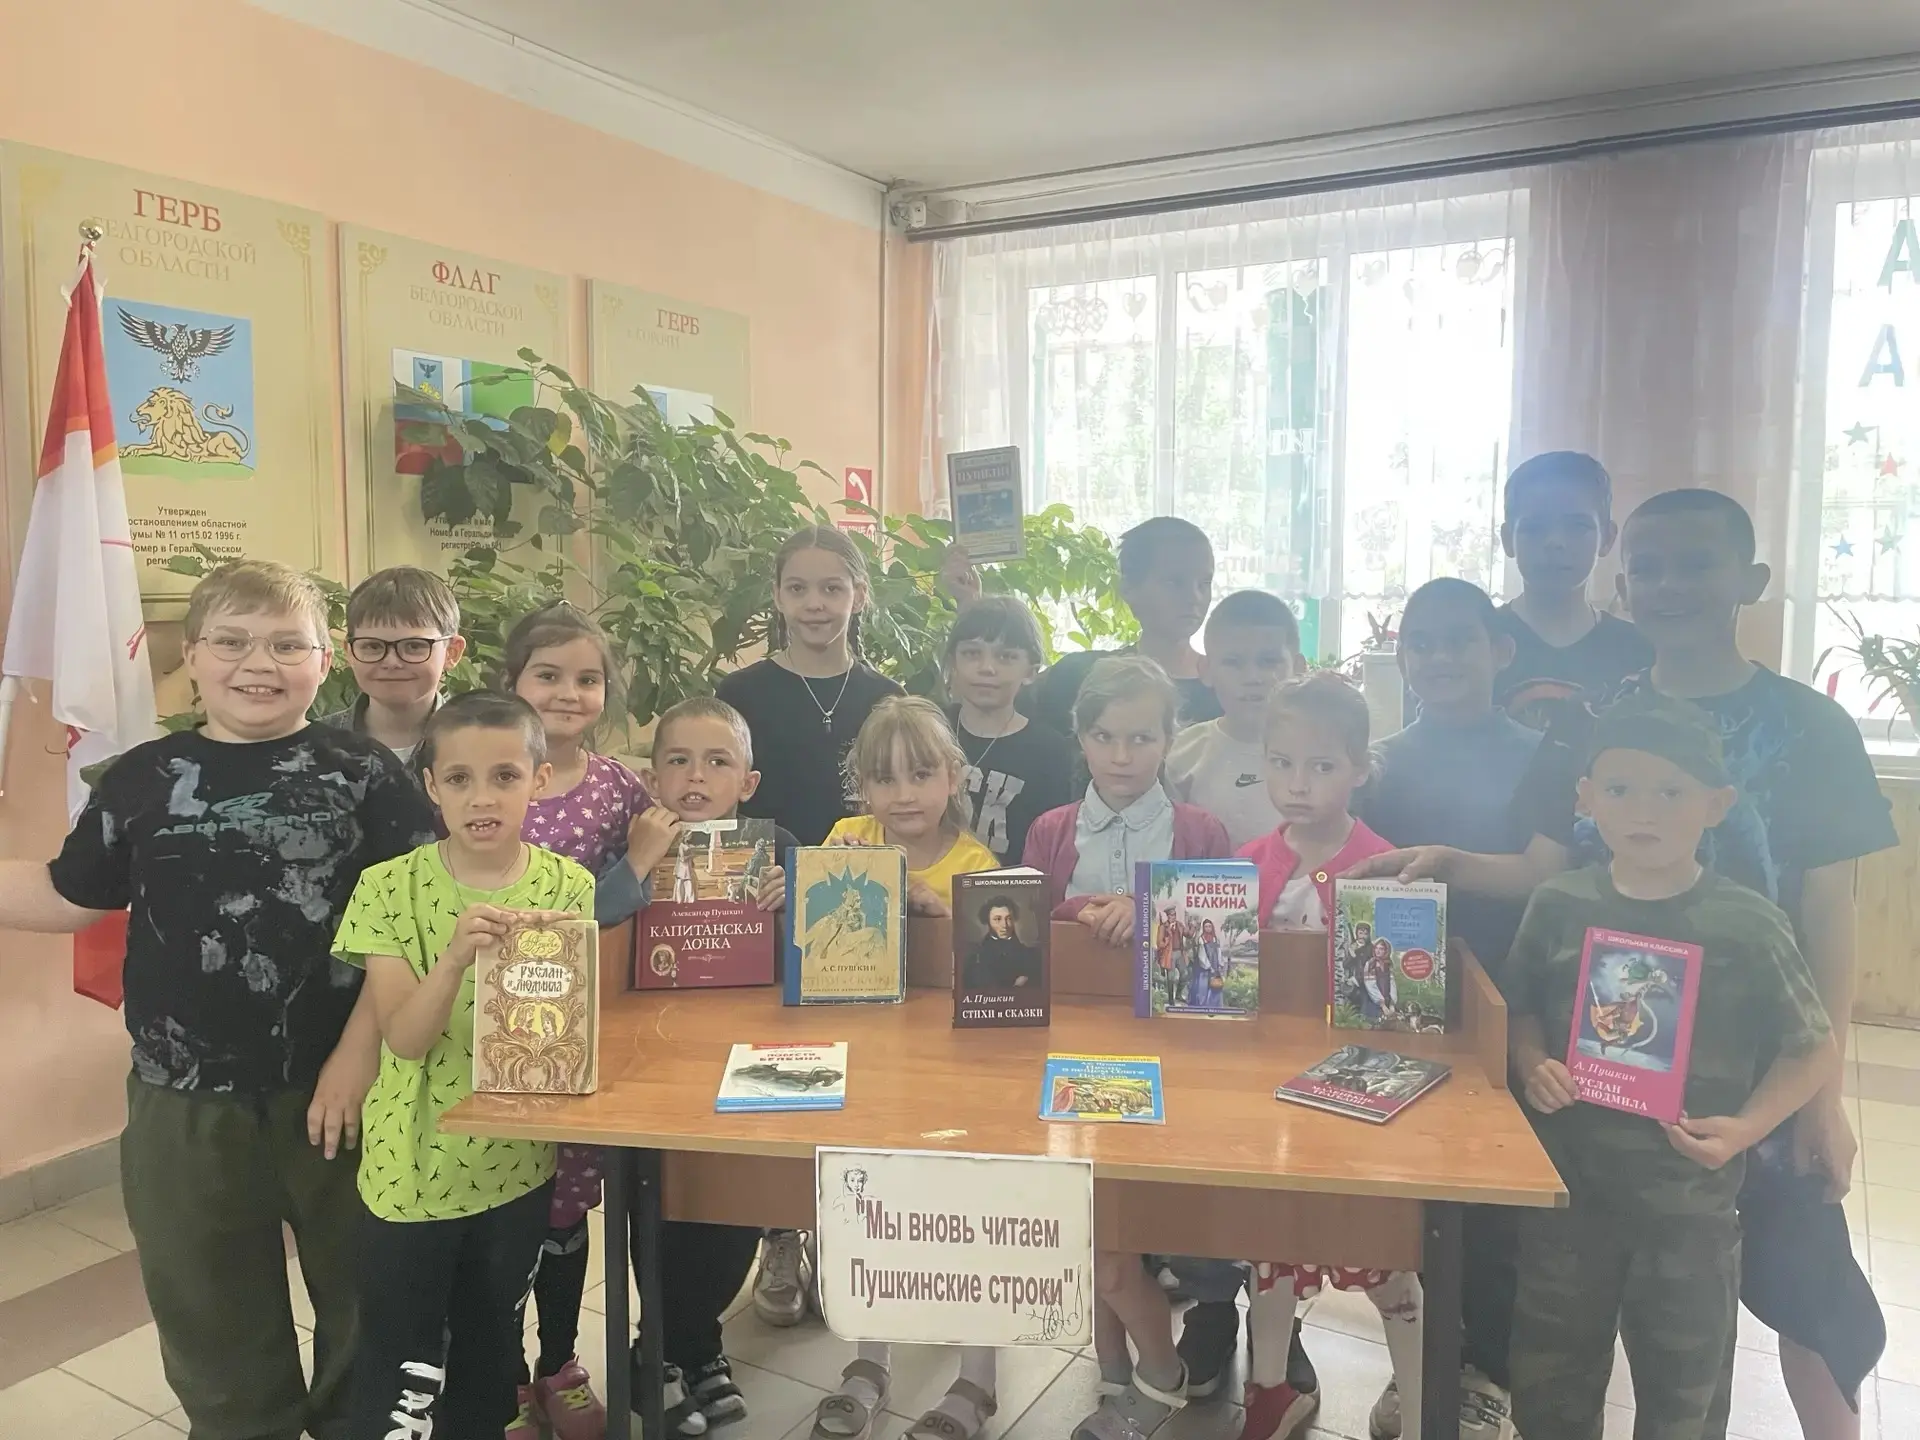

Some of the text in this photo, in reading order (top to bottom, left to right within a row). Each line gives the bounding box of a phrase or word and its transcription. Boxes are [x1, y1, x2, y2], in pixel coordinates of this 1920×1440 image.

[133, 189, 222, 232] ГЕРБ
[120, 246, 230, 281] ОБЛАСТИ
[432, 260, 501, 295] ФЛАГ
[657, 308, 699, 335] ГЕРБ
[158, 506, 207, 517] Утвержден
[127, 518, 247, 528] остановлением областной
[130, 529, 152, 540] умы
[169, 530, 177, 539] 11
[1187, 882, 1247, 895] ПОВЕСТИ
[1186, 896, 1248, 909] БЕЛКИНА
[671, 909, 744, 918] Александр Пушкин
[649, 922, 763, 938] КАПИТАНСКАЯ
[681, 937, 732, 952] ДОЧКА
[1607, 935, 1690, 955] ШКОЛЬНАЯ КЛАССИКА
[962, 994, 1015, 1005] А. Пушкин
[962, 1009, 995, 1019] СТИХИ
[1005, 1008, 1043, 1018] СКАЗКИ
[1573, 1061, 1637, 1082] А. Пушкин
[1581, 1087, 1648, 1111] ЛЮДМИЛА
[909, 1212, 975, 1244] вновь
[981, 1215, 1060, 1248] читаем
[850, 1258, 1074, 1313] Пушкинские строки"
